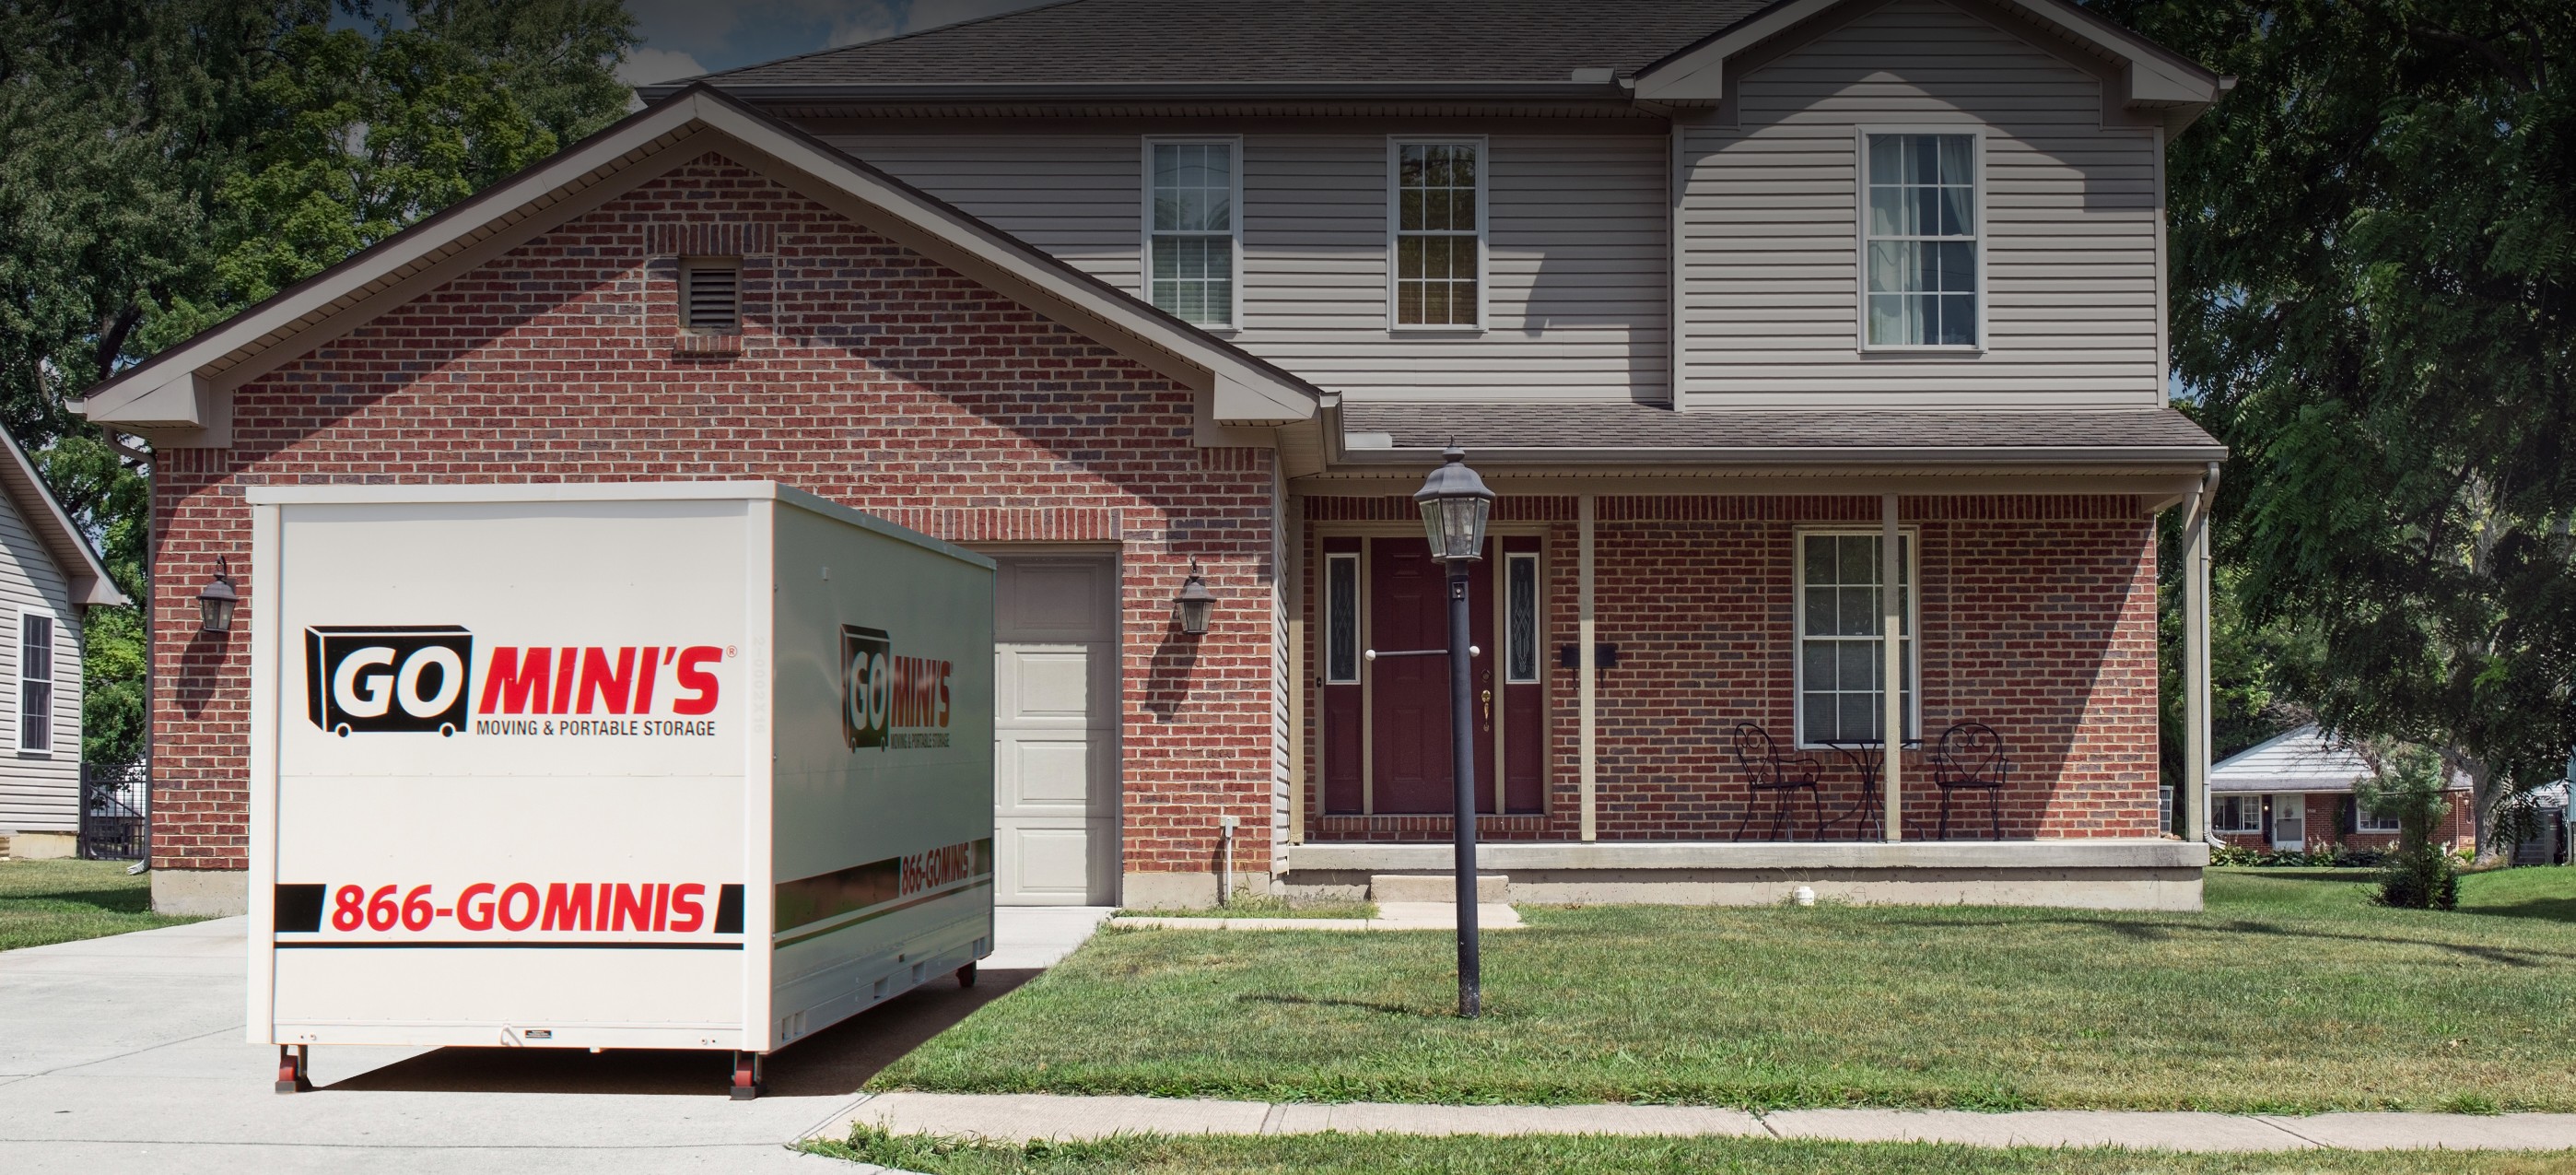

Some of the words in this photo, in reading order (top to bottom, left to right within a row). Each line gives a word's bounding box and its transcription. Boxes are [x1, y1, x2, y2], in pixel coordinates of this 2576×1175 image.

[333, 645, 463, 718] GO
[477, 645, 723, 715] MINI'S
[849, 651, 888, 731] GO
[890, 655, 951, 728] MINI'S
[476, 720, 538, 736] MOVING
[543, 721, 555, 735] &
[559, 721, 641, 735] PORTABLE
[643, 721, 716, 736] STORAGE
[890, 734, 907, 749] MOVING
[911, 734, 932, 748] PORTABLE
[932, 734, 950, 747] STORAGE
[902, 842, 969, 896] 866-GOMINIS
[332, 882, 707, 933] 866-GOMINIS
